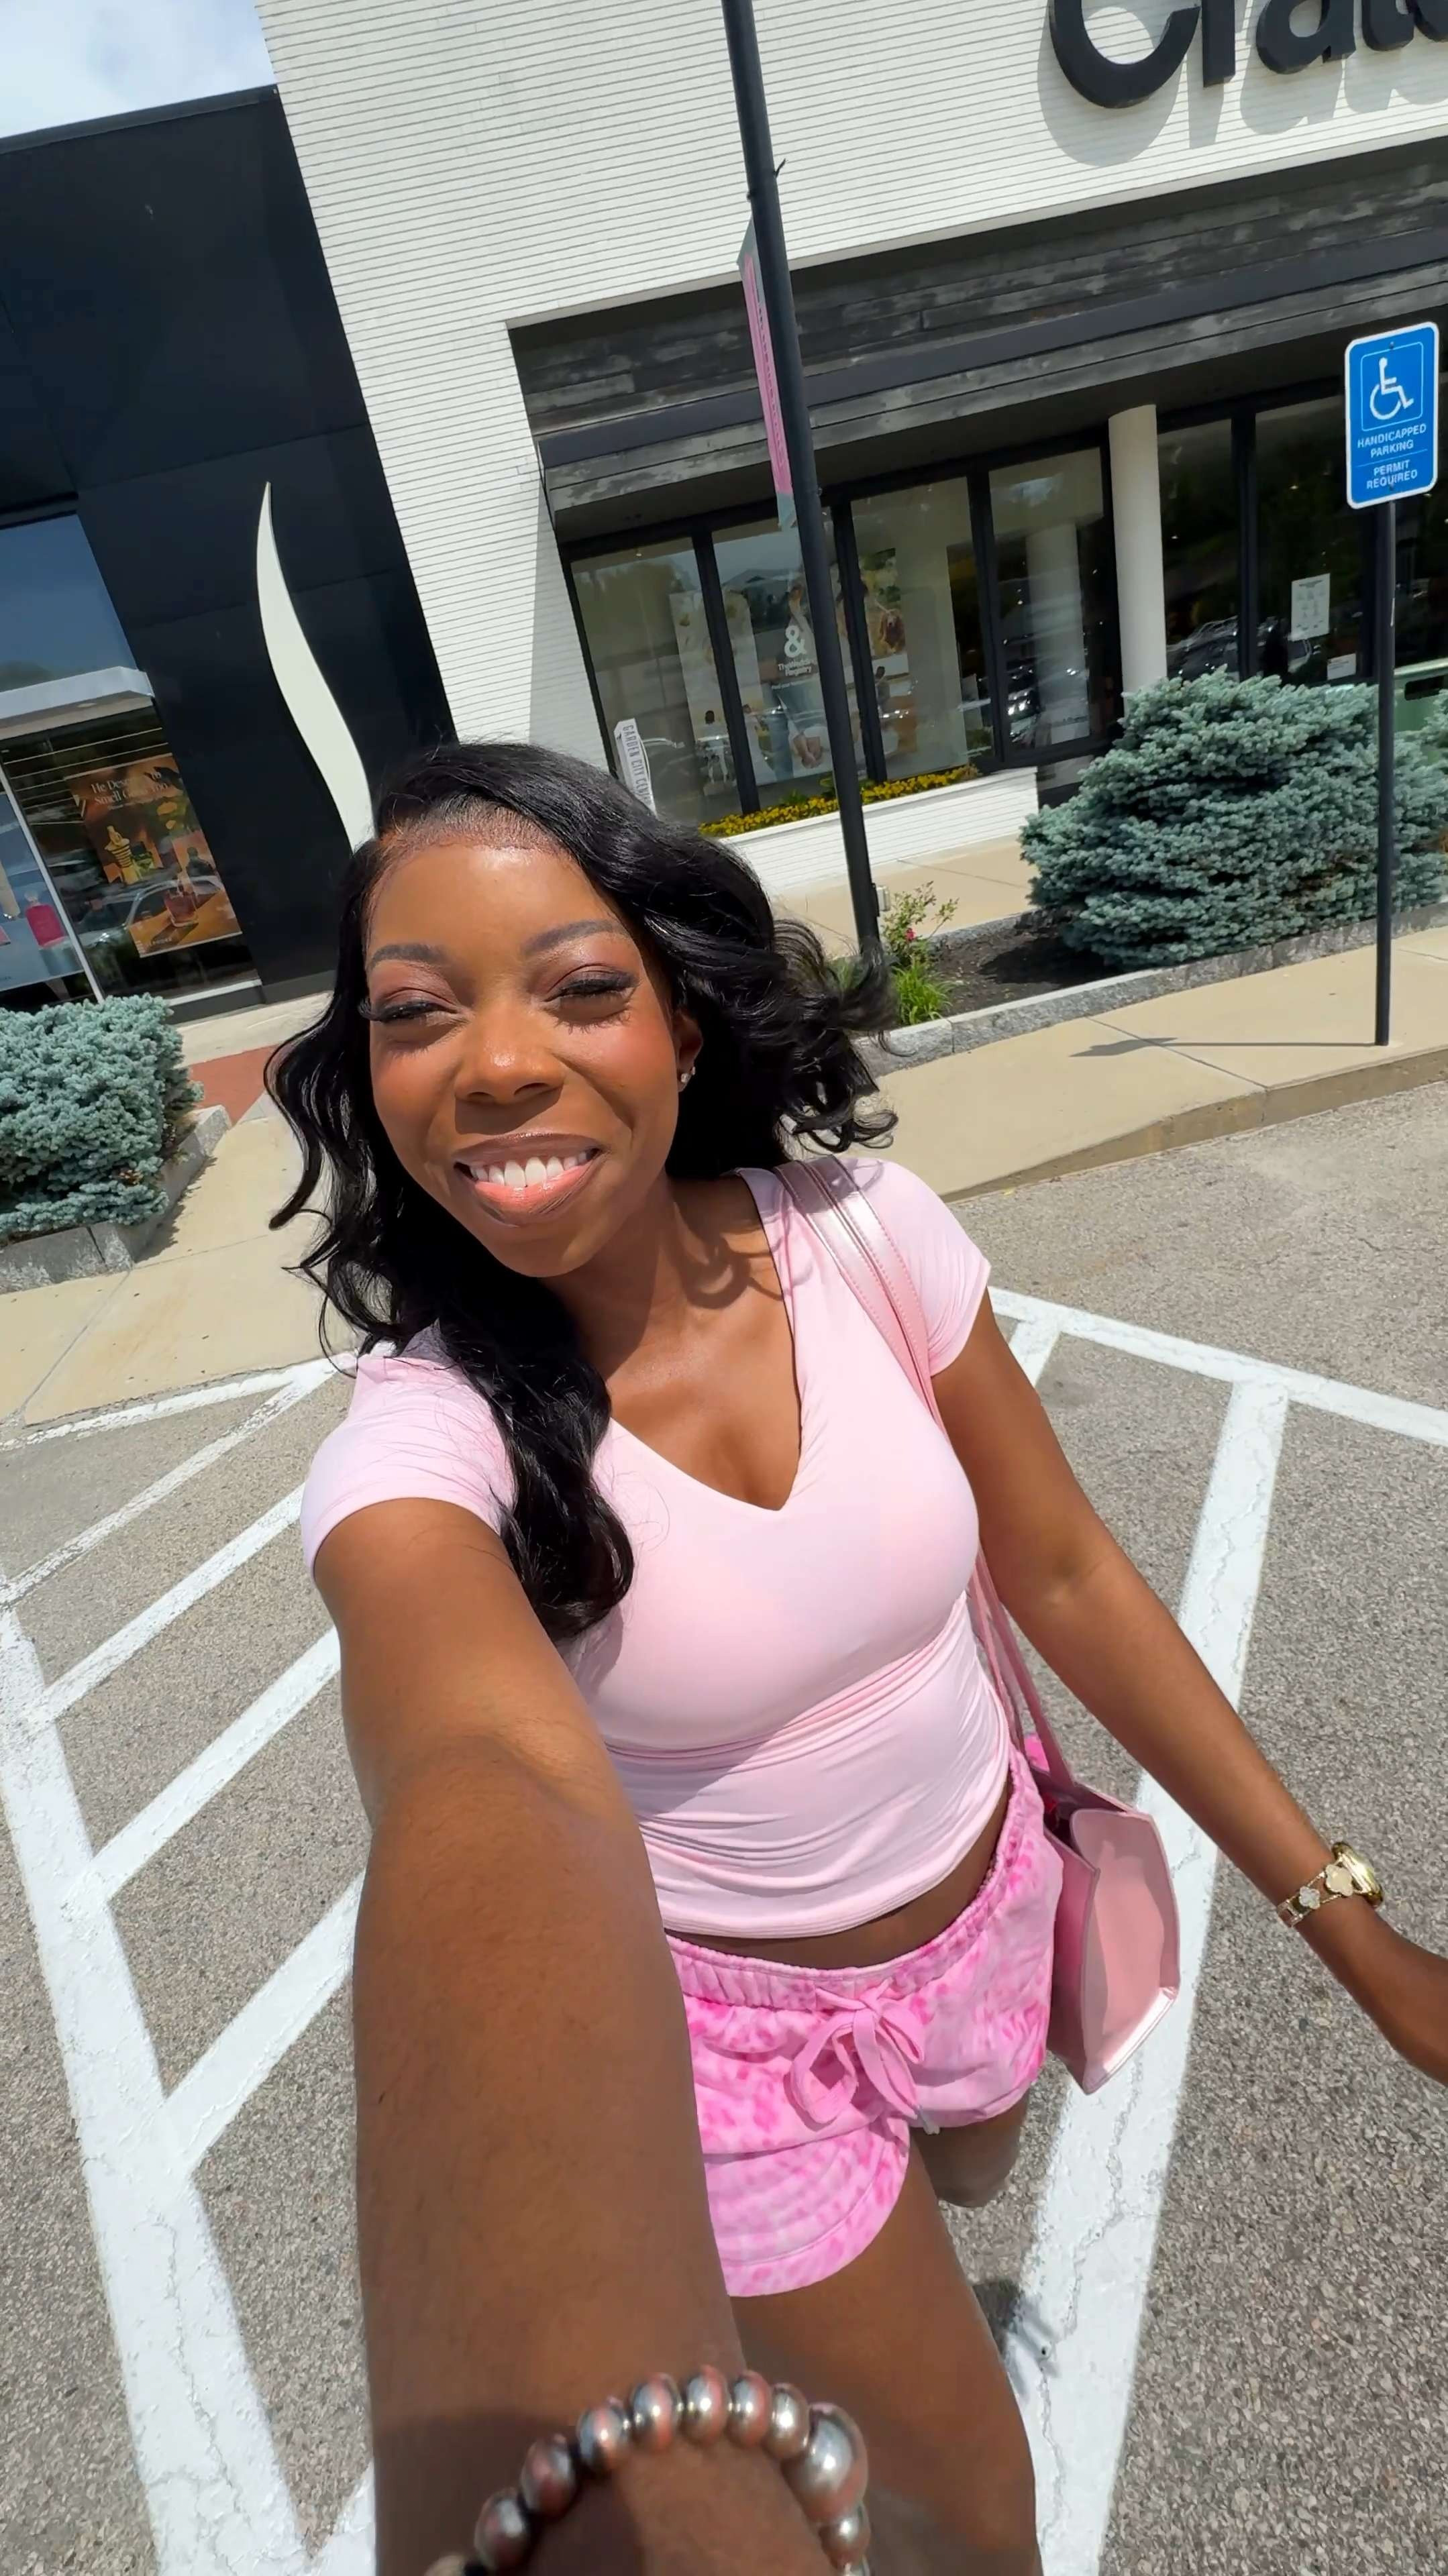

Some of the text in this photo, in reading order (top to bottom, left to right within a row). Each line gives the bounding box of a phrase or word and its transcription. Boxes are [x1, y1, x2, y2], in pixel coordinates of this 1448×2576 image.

[1357, 423, 1427, 448] HANDICAPPED
[1370, 439, 1414, 458] PARKING
[1374, 460, 1410, 476] PERMIT
[1366, 470, 1418, 489] REQUIRED
[784, 625, 807, 658] &
[623, 724, 640, 757] GARDEN
[631, 759, 645, 776] CITY
[91, 783, 105, 794] He
[95, 790, 122, 805] Smell
